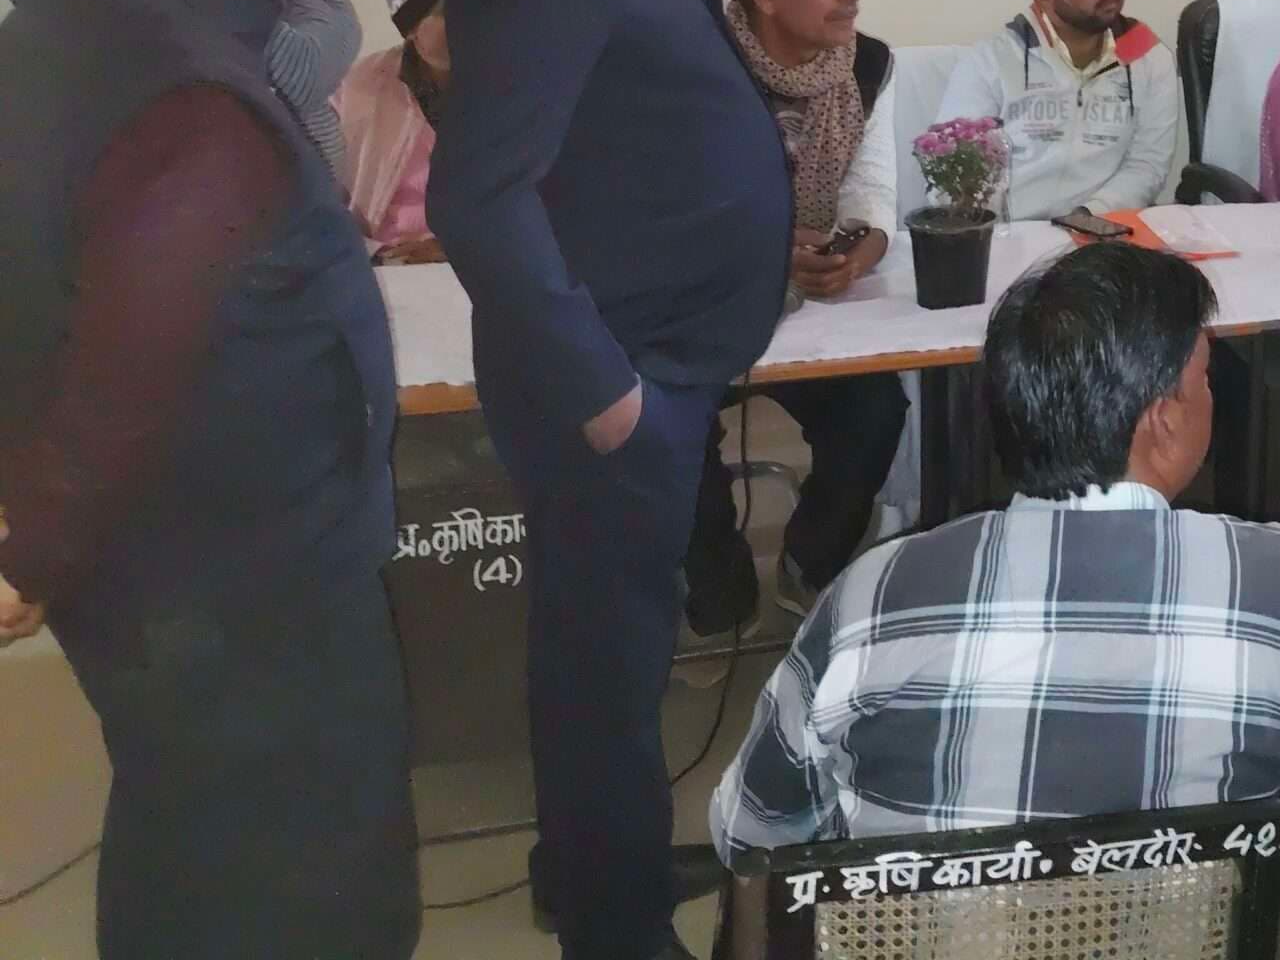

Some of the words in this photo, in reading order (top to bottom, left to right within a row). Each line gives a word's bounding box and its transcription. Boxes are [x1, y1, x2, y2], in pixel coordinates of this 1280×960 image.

[1007, 99, 1069, 121] RHODE
[432, 507, 484, 565] कृषि
[473, 554, 523, 591] (4)
[840, 851, 933, 900] कृषि
